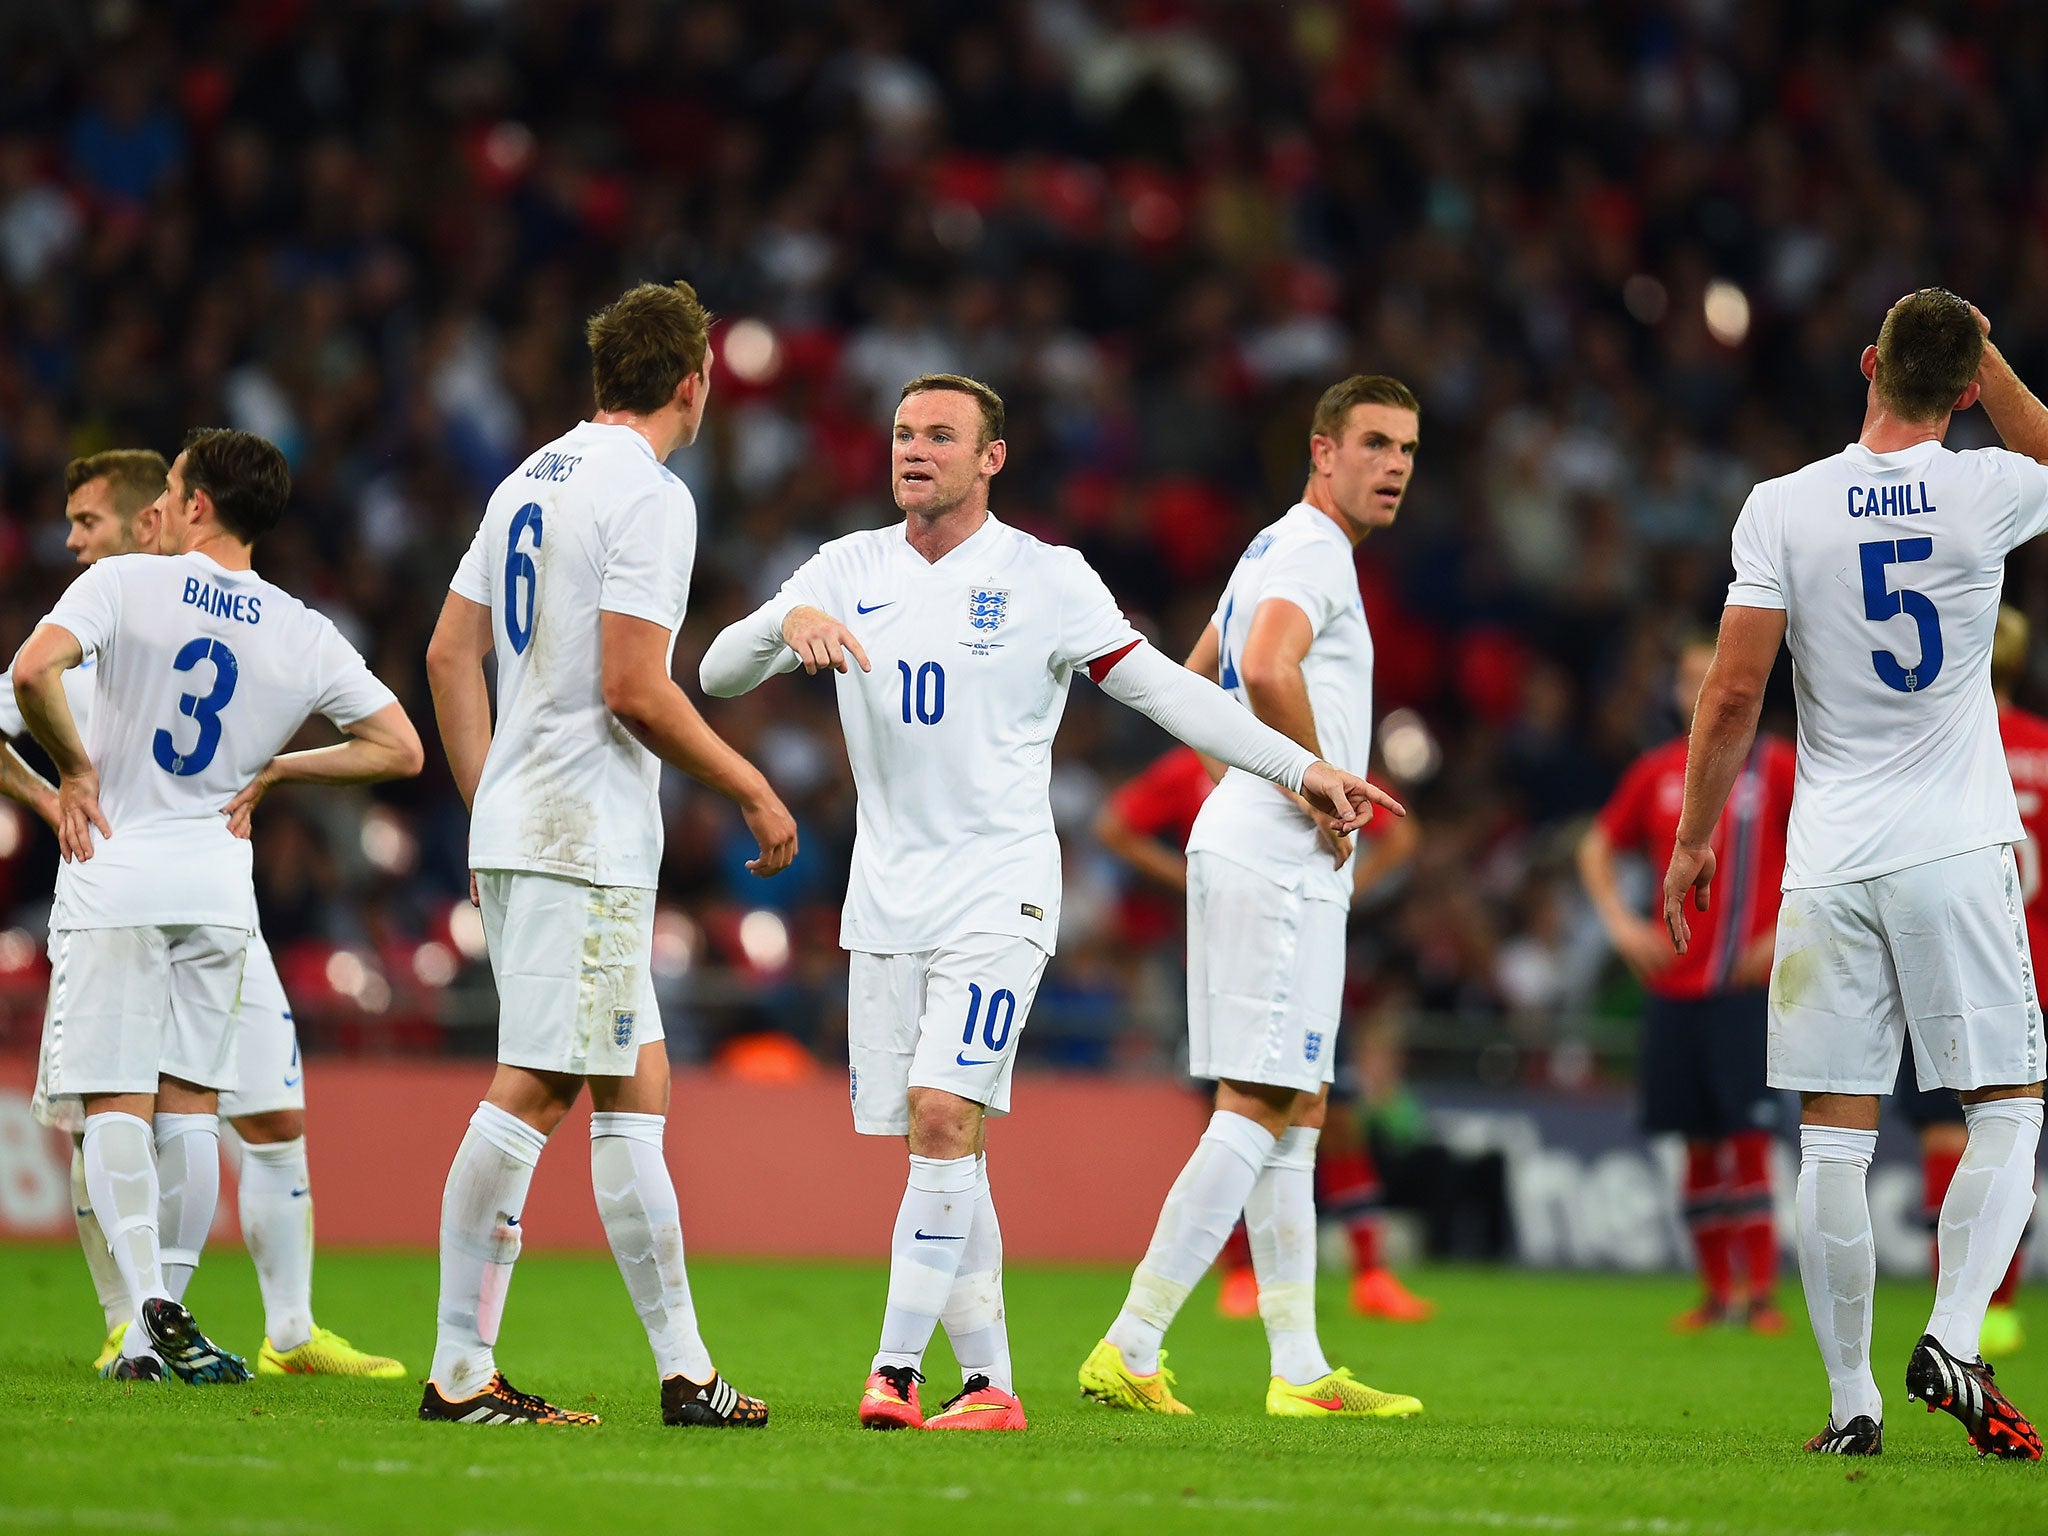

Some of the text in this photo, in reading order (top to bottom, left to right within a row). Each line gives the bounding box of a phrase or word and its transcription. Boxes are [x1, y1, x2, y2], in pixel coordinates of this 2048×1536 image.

[526, 452, 582, 482] JONES
[1848, 481, 1937, 517] CAHILL
[182, 576, 262, 625] BAINES
[505, 502, 543, 656] 6
[1859, 537, 1944, 692] 5
[153, 637, 239, 776] 3
[898, 659, 945, 726] 10
[962, 982, 1016, 1052] 10
